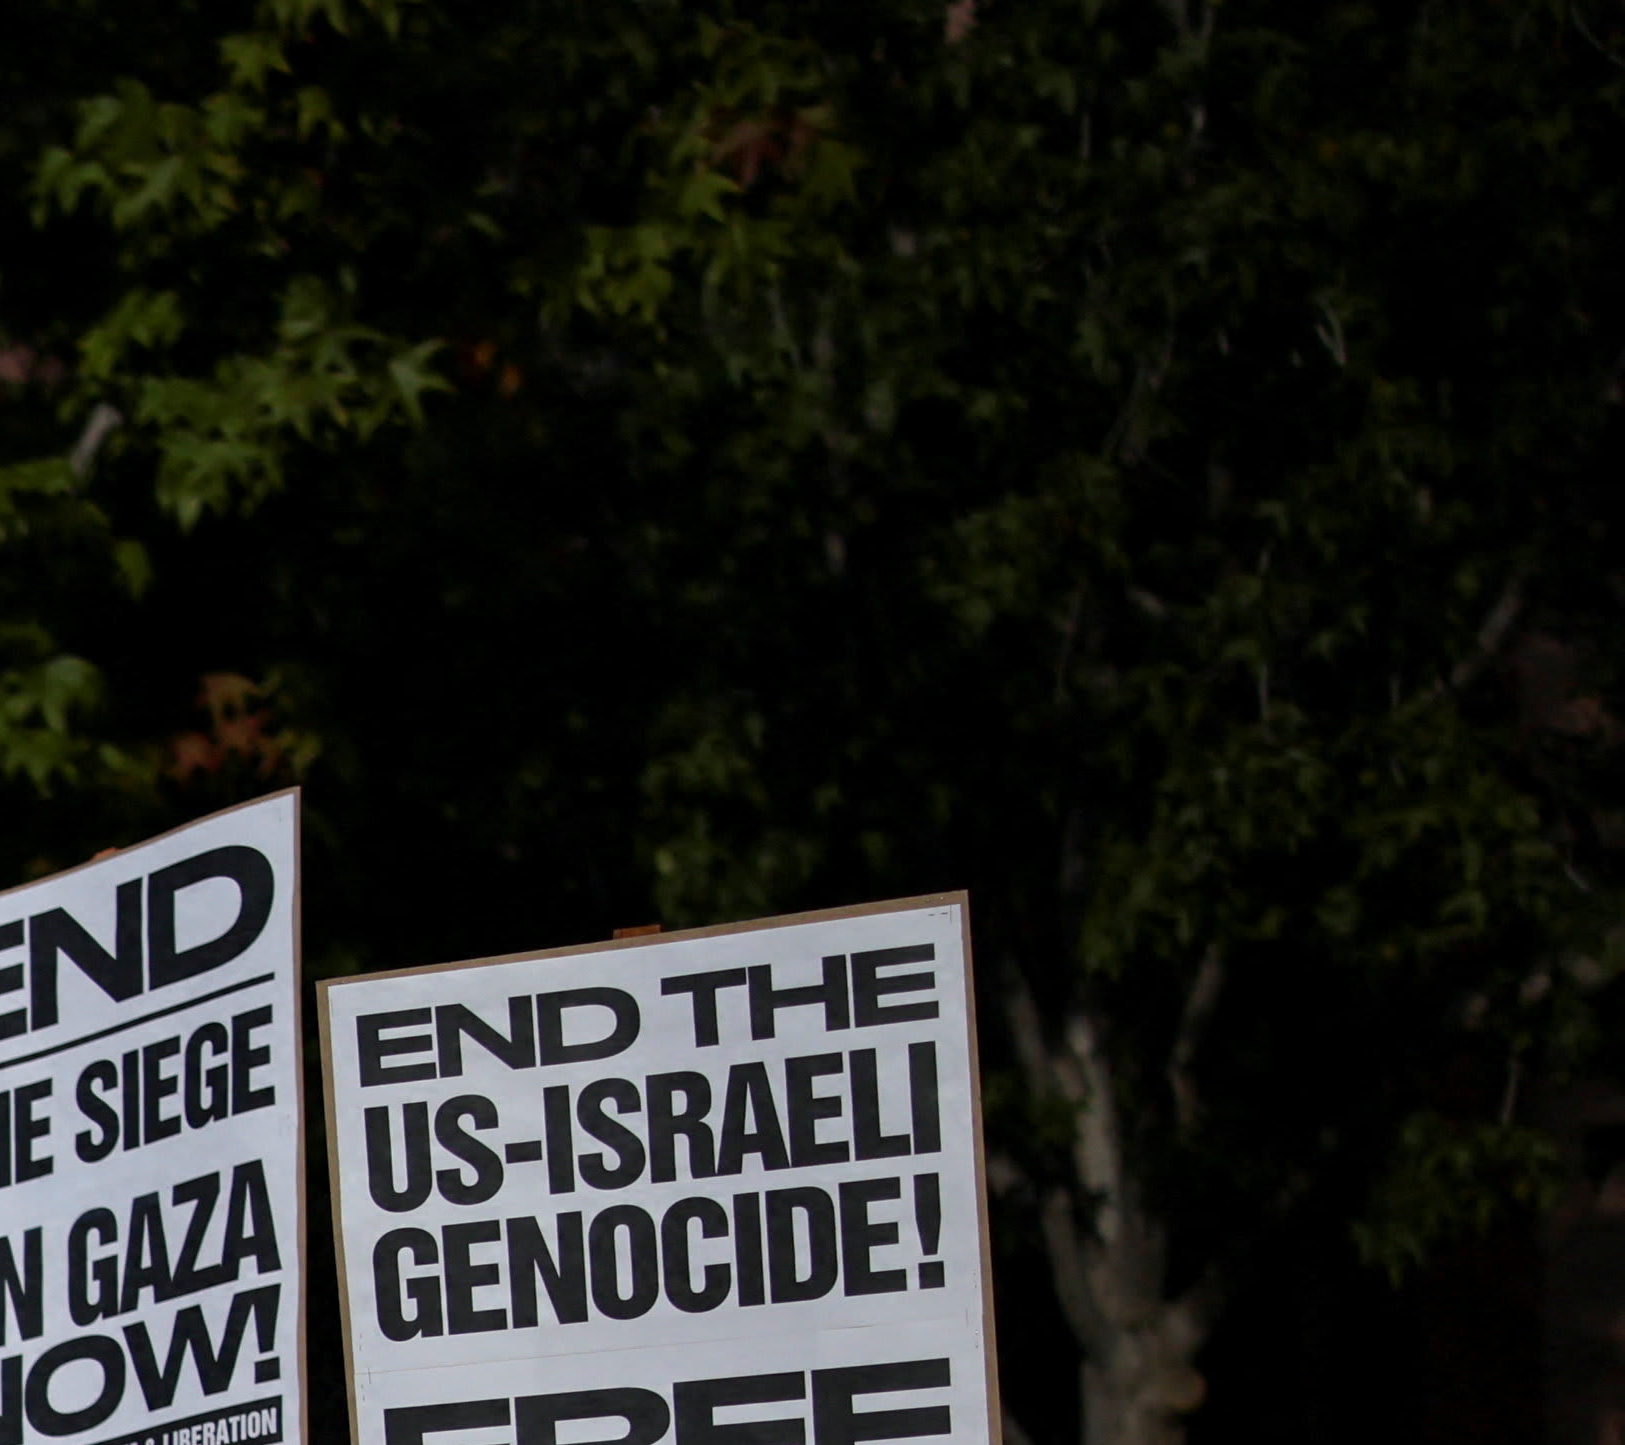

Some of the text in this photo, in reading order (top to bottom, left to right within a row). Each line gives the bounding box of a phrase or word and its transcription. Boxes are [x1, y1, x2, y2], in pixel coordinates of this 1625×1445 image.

[76, 1005, 276, 1163] SIEGE
[356, 943, 940, 1087] END THE
[363, 1040, 942, 1213] US-ISRAELI
[67, 1159, 282, 1328] GAZA
[372, 1172, 946, 1342] GENOCIDE!
